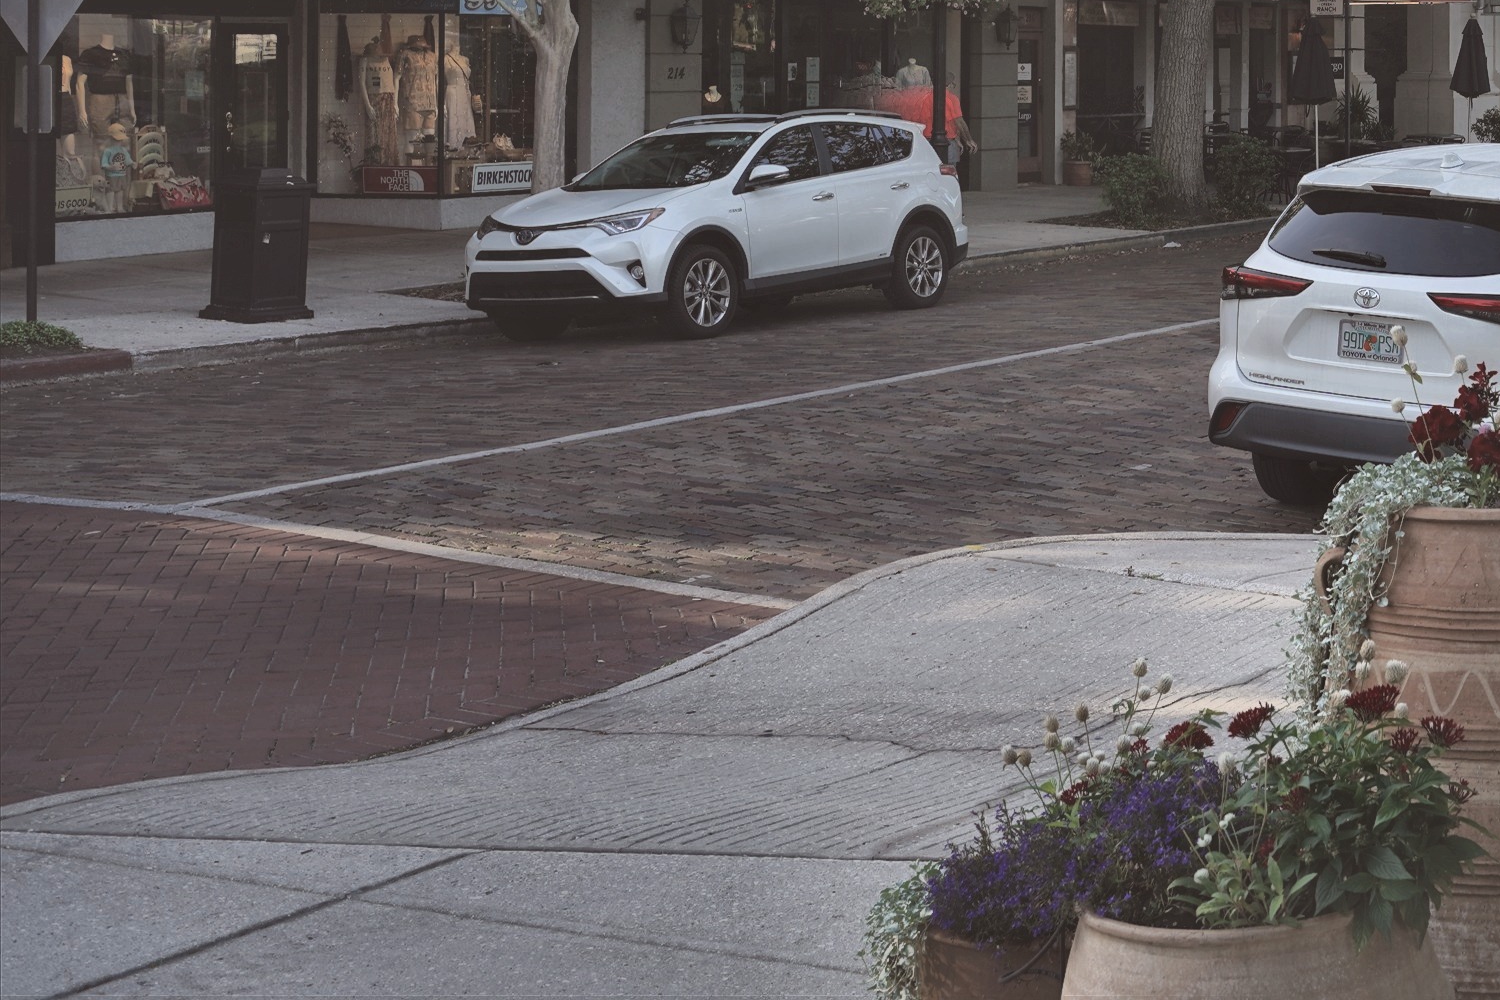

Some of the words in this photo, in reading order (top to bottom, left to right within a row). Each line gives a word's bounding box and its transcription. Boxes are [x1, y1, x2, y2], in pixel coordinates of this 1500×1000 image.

[667, 67, 685, 79] 214
[58, 200, 65, 209] IS
[66, 198, 87, 208] GOOD
[1373, 354, 1398, 363] Orlando
